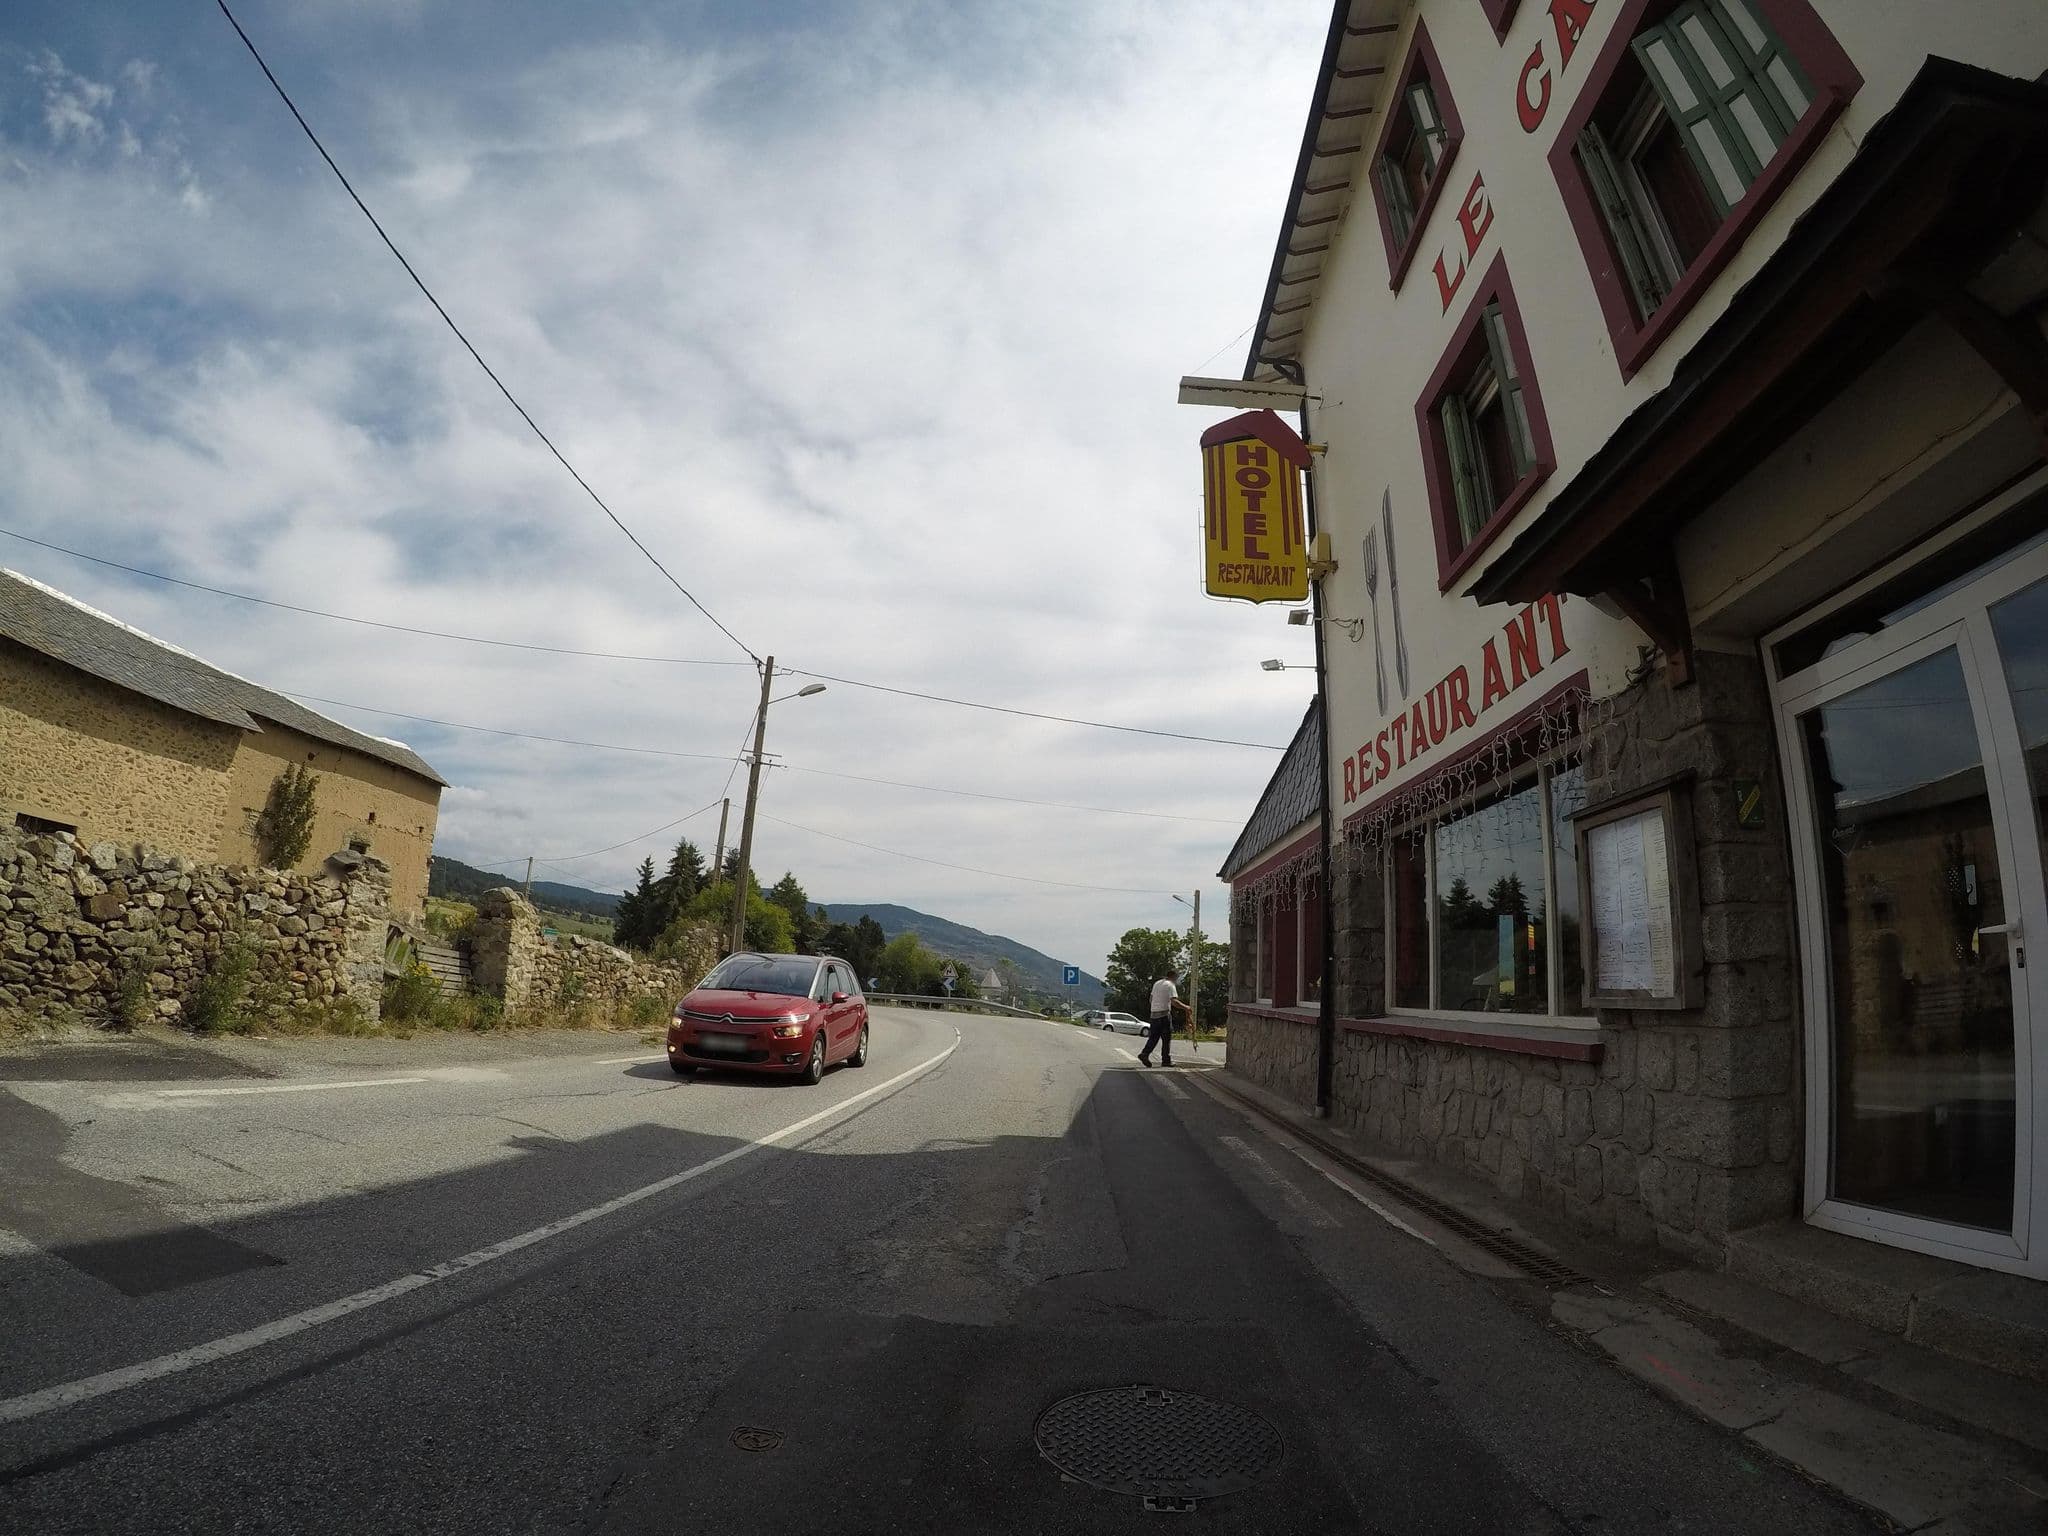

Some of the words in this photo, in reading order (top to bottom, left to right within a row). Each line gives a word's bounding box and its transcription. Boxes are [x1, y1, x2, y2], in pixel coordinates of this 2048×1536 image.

[1432, 169, 1494, 317] LE
[1235, 445, 1271, 560] HOTEL
[1217, 562, 1296, 586] RESTAURANT
[1343, 591, 1571, 804] RESTAURANT
[1067, 969, 1075, 982] P
